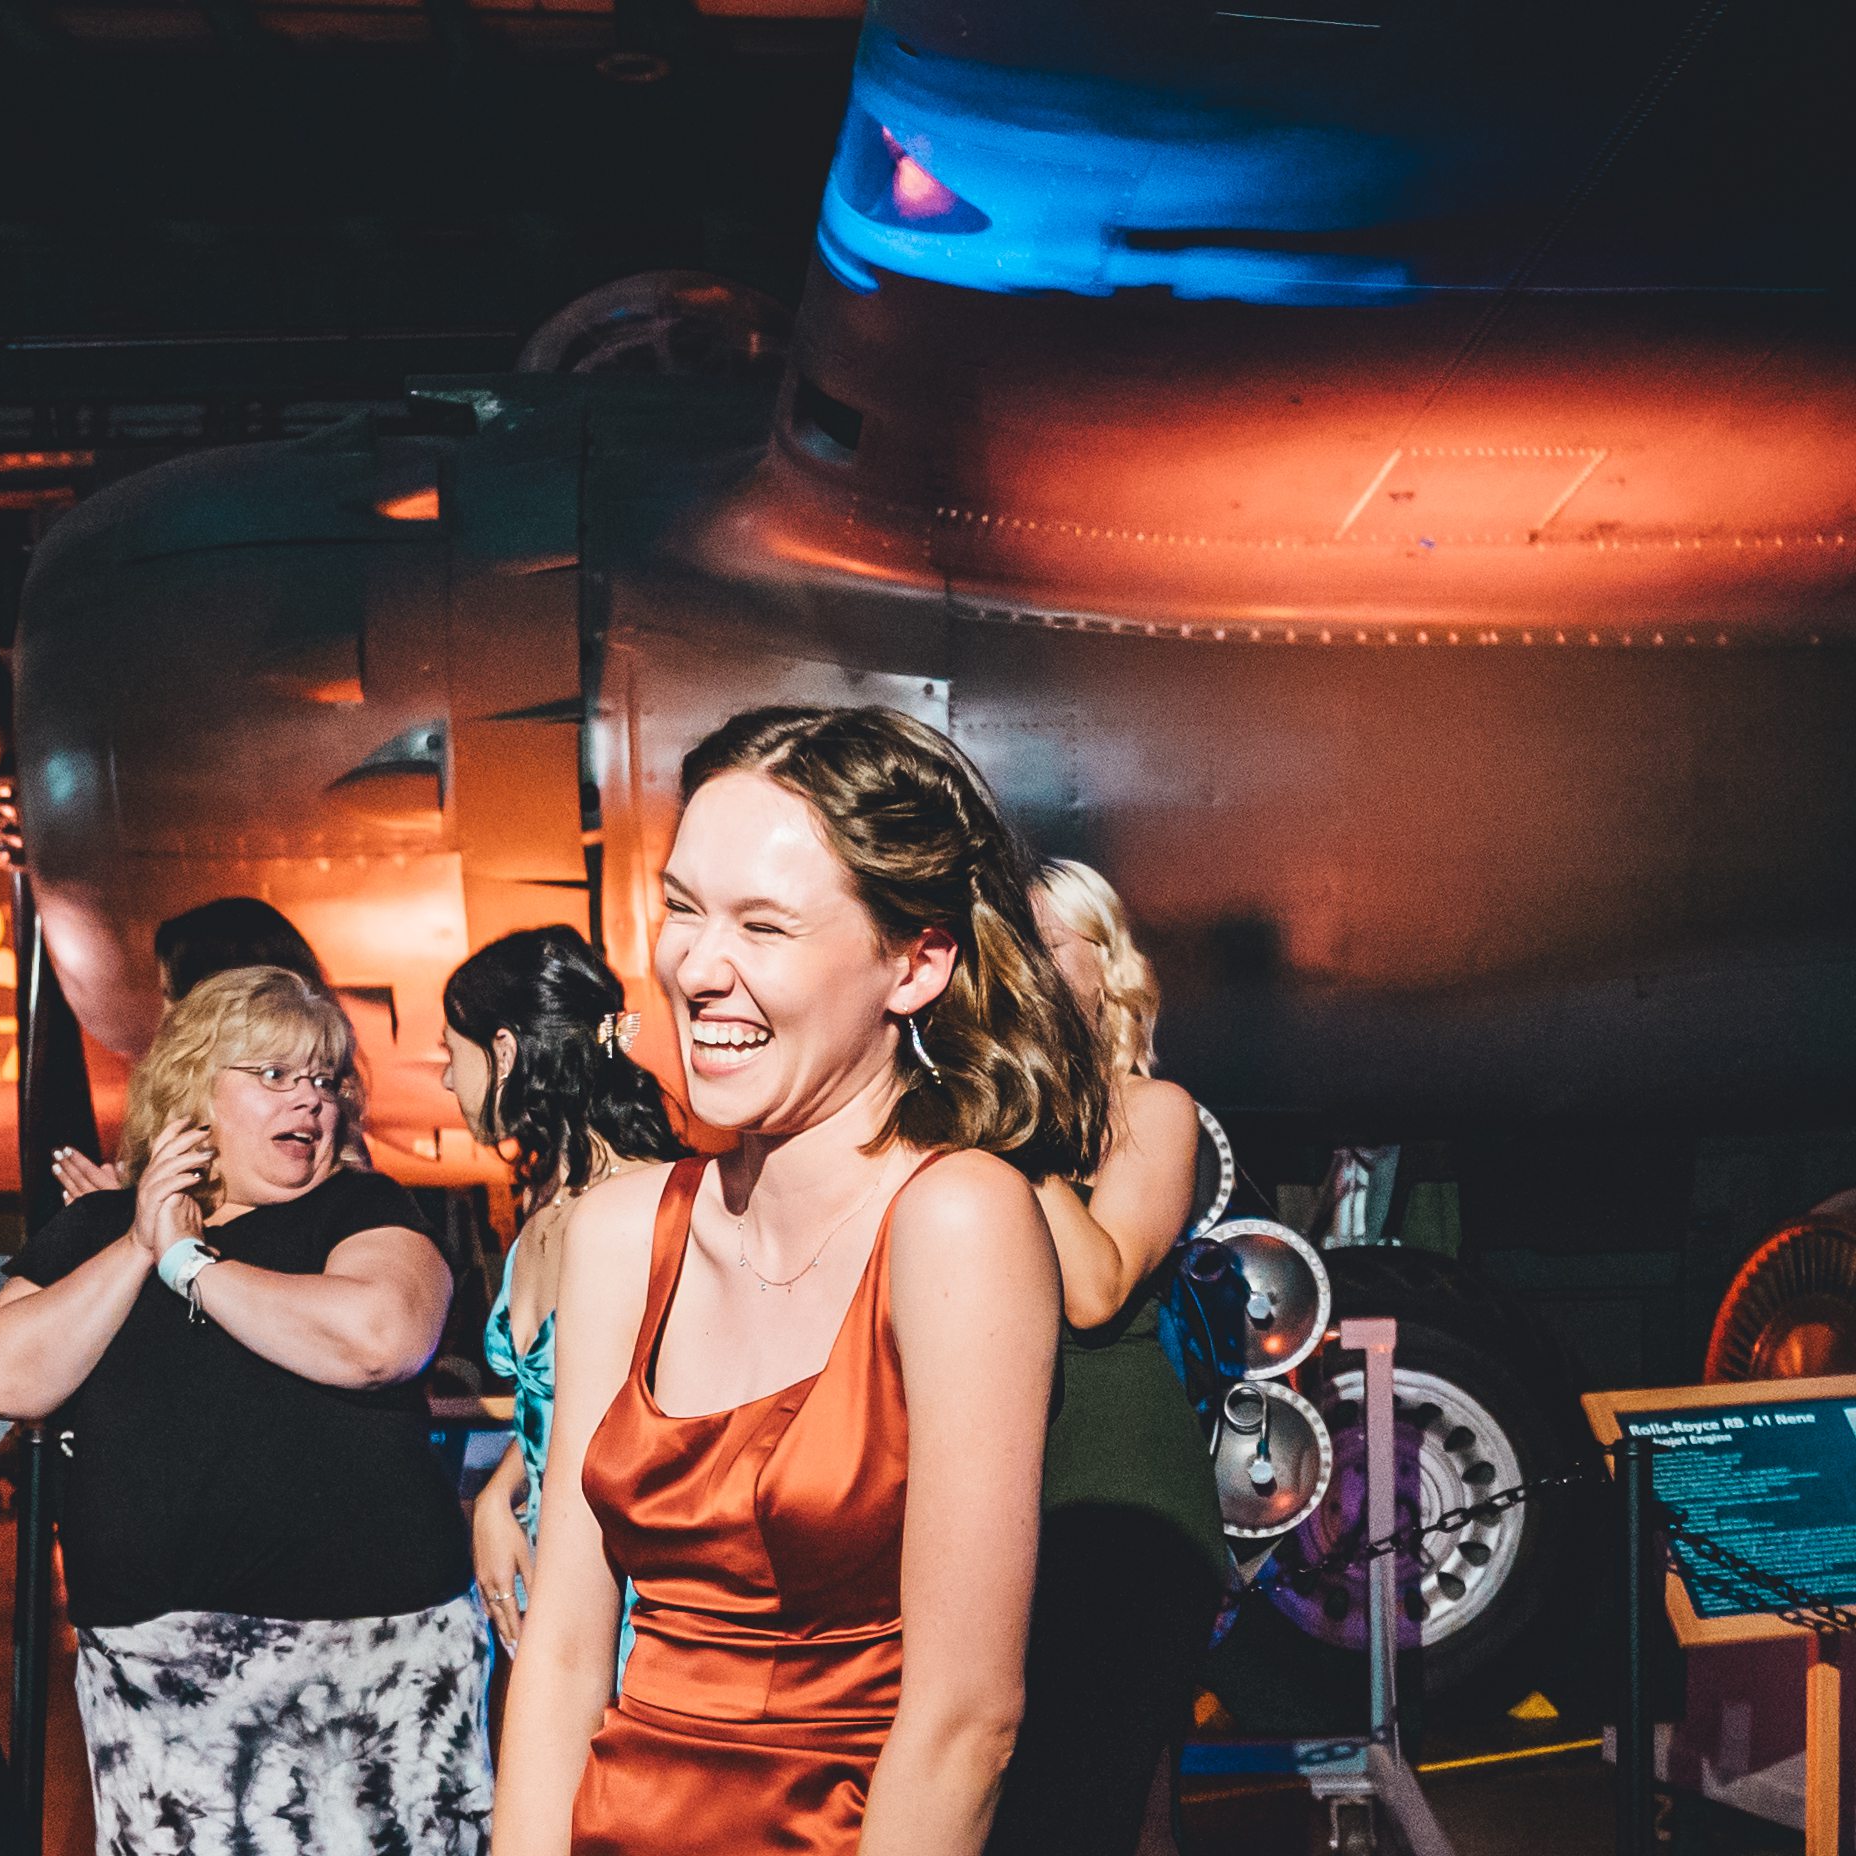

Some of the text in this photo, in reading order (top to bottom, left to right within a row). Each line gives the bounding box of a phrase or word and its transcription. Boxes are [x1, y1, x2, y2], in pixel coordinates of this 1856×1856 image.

[1628, 1420, 1721, 1437] Rolls-Royce
[1752, 1414, 1772, 1427] 41
[1774, 1412, 1816, 1426] Nene
[1688, 1433, 1733, 1445] Engine
